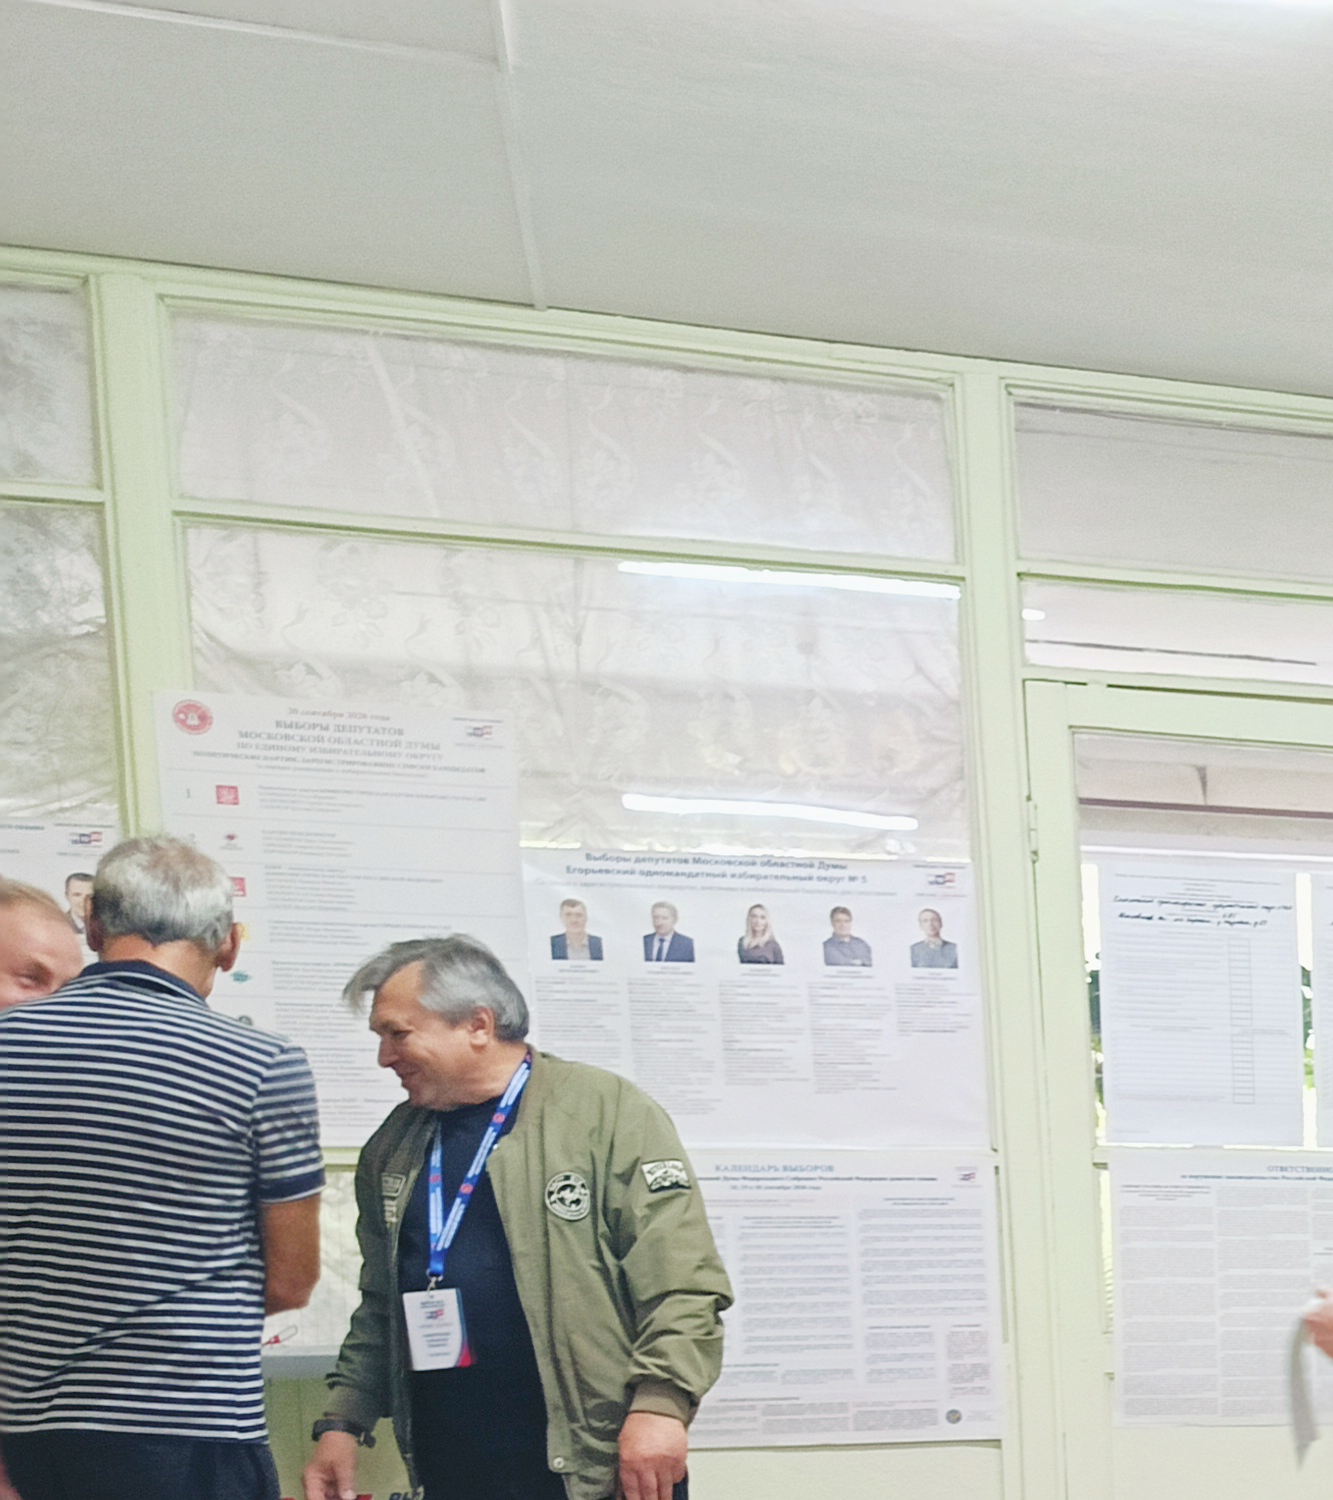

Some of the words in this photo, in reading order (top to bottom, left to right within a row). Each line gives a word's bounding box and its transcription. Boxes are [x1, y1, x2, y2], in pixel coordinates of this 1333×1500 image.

[275, 720, 330, 732] ВЫБОРЫ
[333, 723, 404, 737] ДЕПУТАТОВ
[238, 730, 325, 744] МОСКОВСКОЙ
[327, 734, 402, 748] ОБЛАСТНОЙ
[405, 739, 441, 751] ДУМЫ
[585, 853, 631, 864] Выборы
[634, 855, 690, 866] депутатов
[692, 857, 757, 867] Московской
[760, 859, 815, 869] областной
[817, 861, 847, 871] Думы
[566, 865, 636, 877] Егорьевский
[638, 868, 728, 879] одномандатный
[730, 872, 814, 882] избирательный
[816, 875, 846, 885] округ
[715, 1164, 780, 1173] КАЛЕНДАРЬ
[782, 1164, 834, 1172] ВЫБОРОВ
